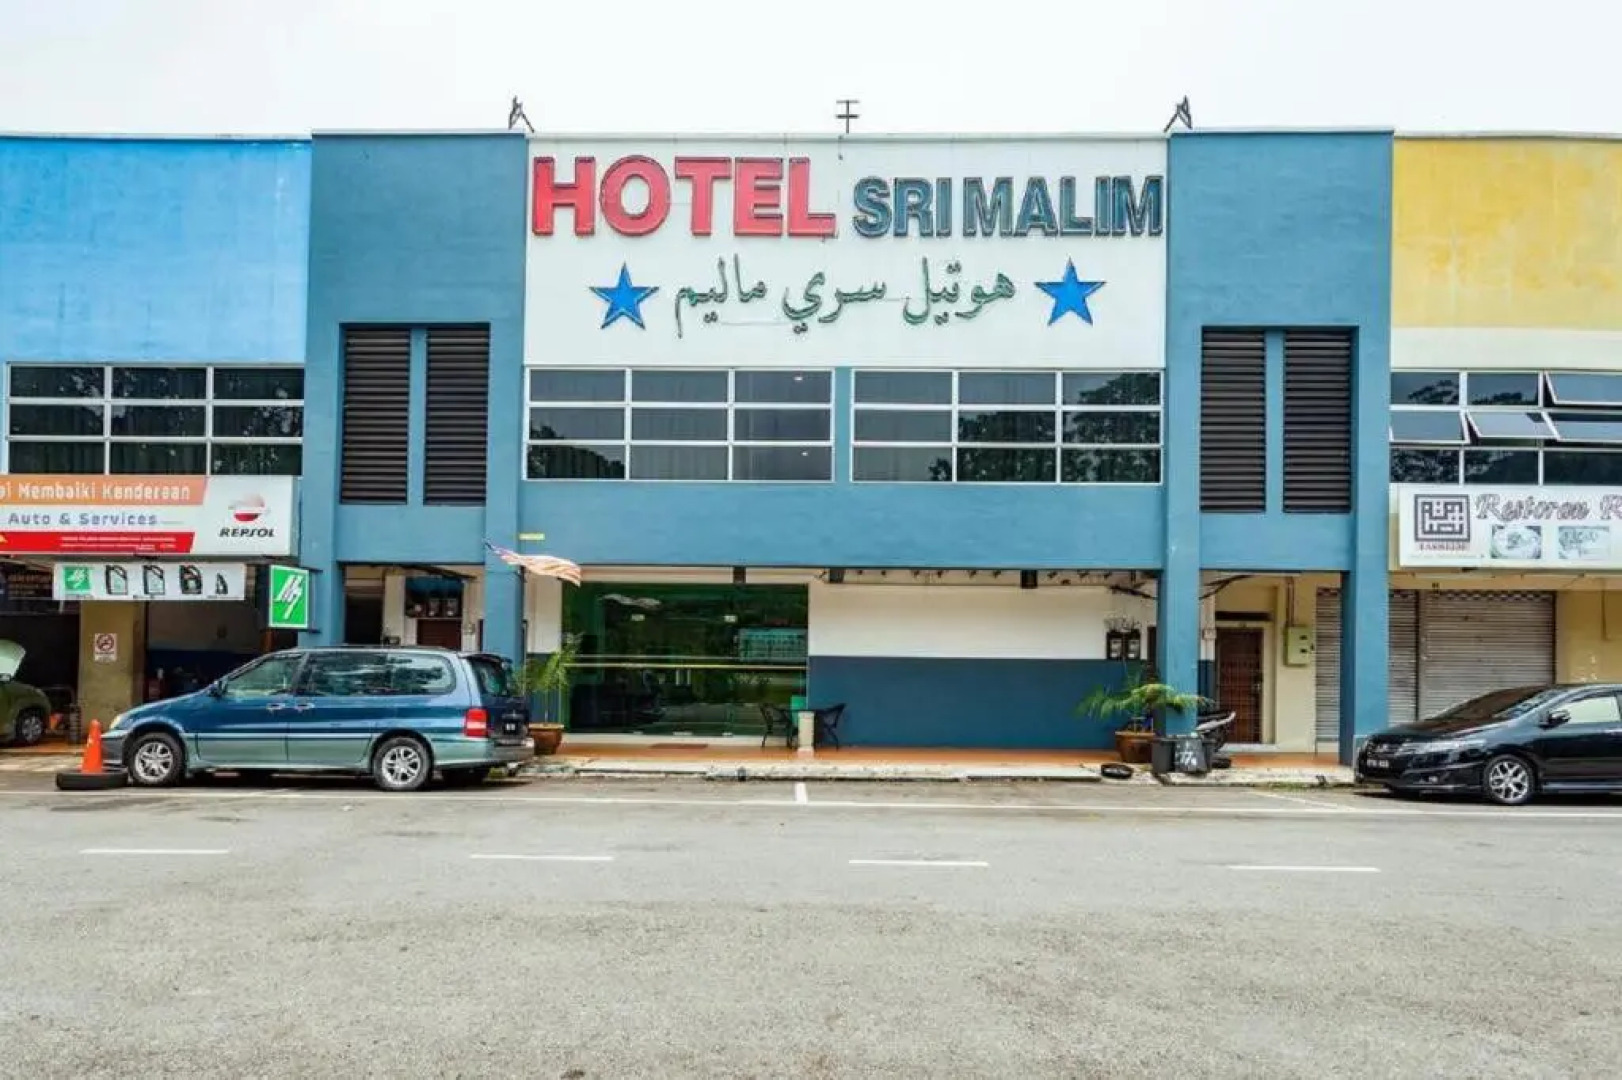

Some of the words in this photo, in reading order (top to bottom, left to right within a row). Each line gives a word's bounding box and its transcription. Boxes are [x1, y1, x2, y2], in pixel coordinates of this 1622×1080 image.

[532, 155, 836, 237] HOTEL
[852, 175, 952, 238] SRI
[962, 175, 1164, 238] MALIM
[674, 253, 768, 339] ماليم
[783, 271, 887, 334] سري
[903, 256, 1016, 325] هوتيل
[8, 512, 51, 525] Auto
[59, 512, 71, 525] &
[79, 511, 158, 525] Services
[19, 481, 96, 500] Membaiki
[219, 526, 276, 538] REPSOL
